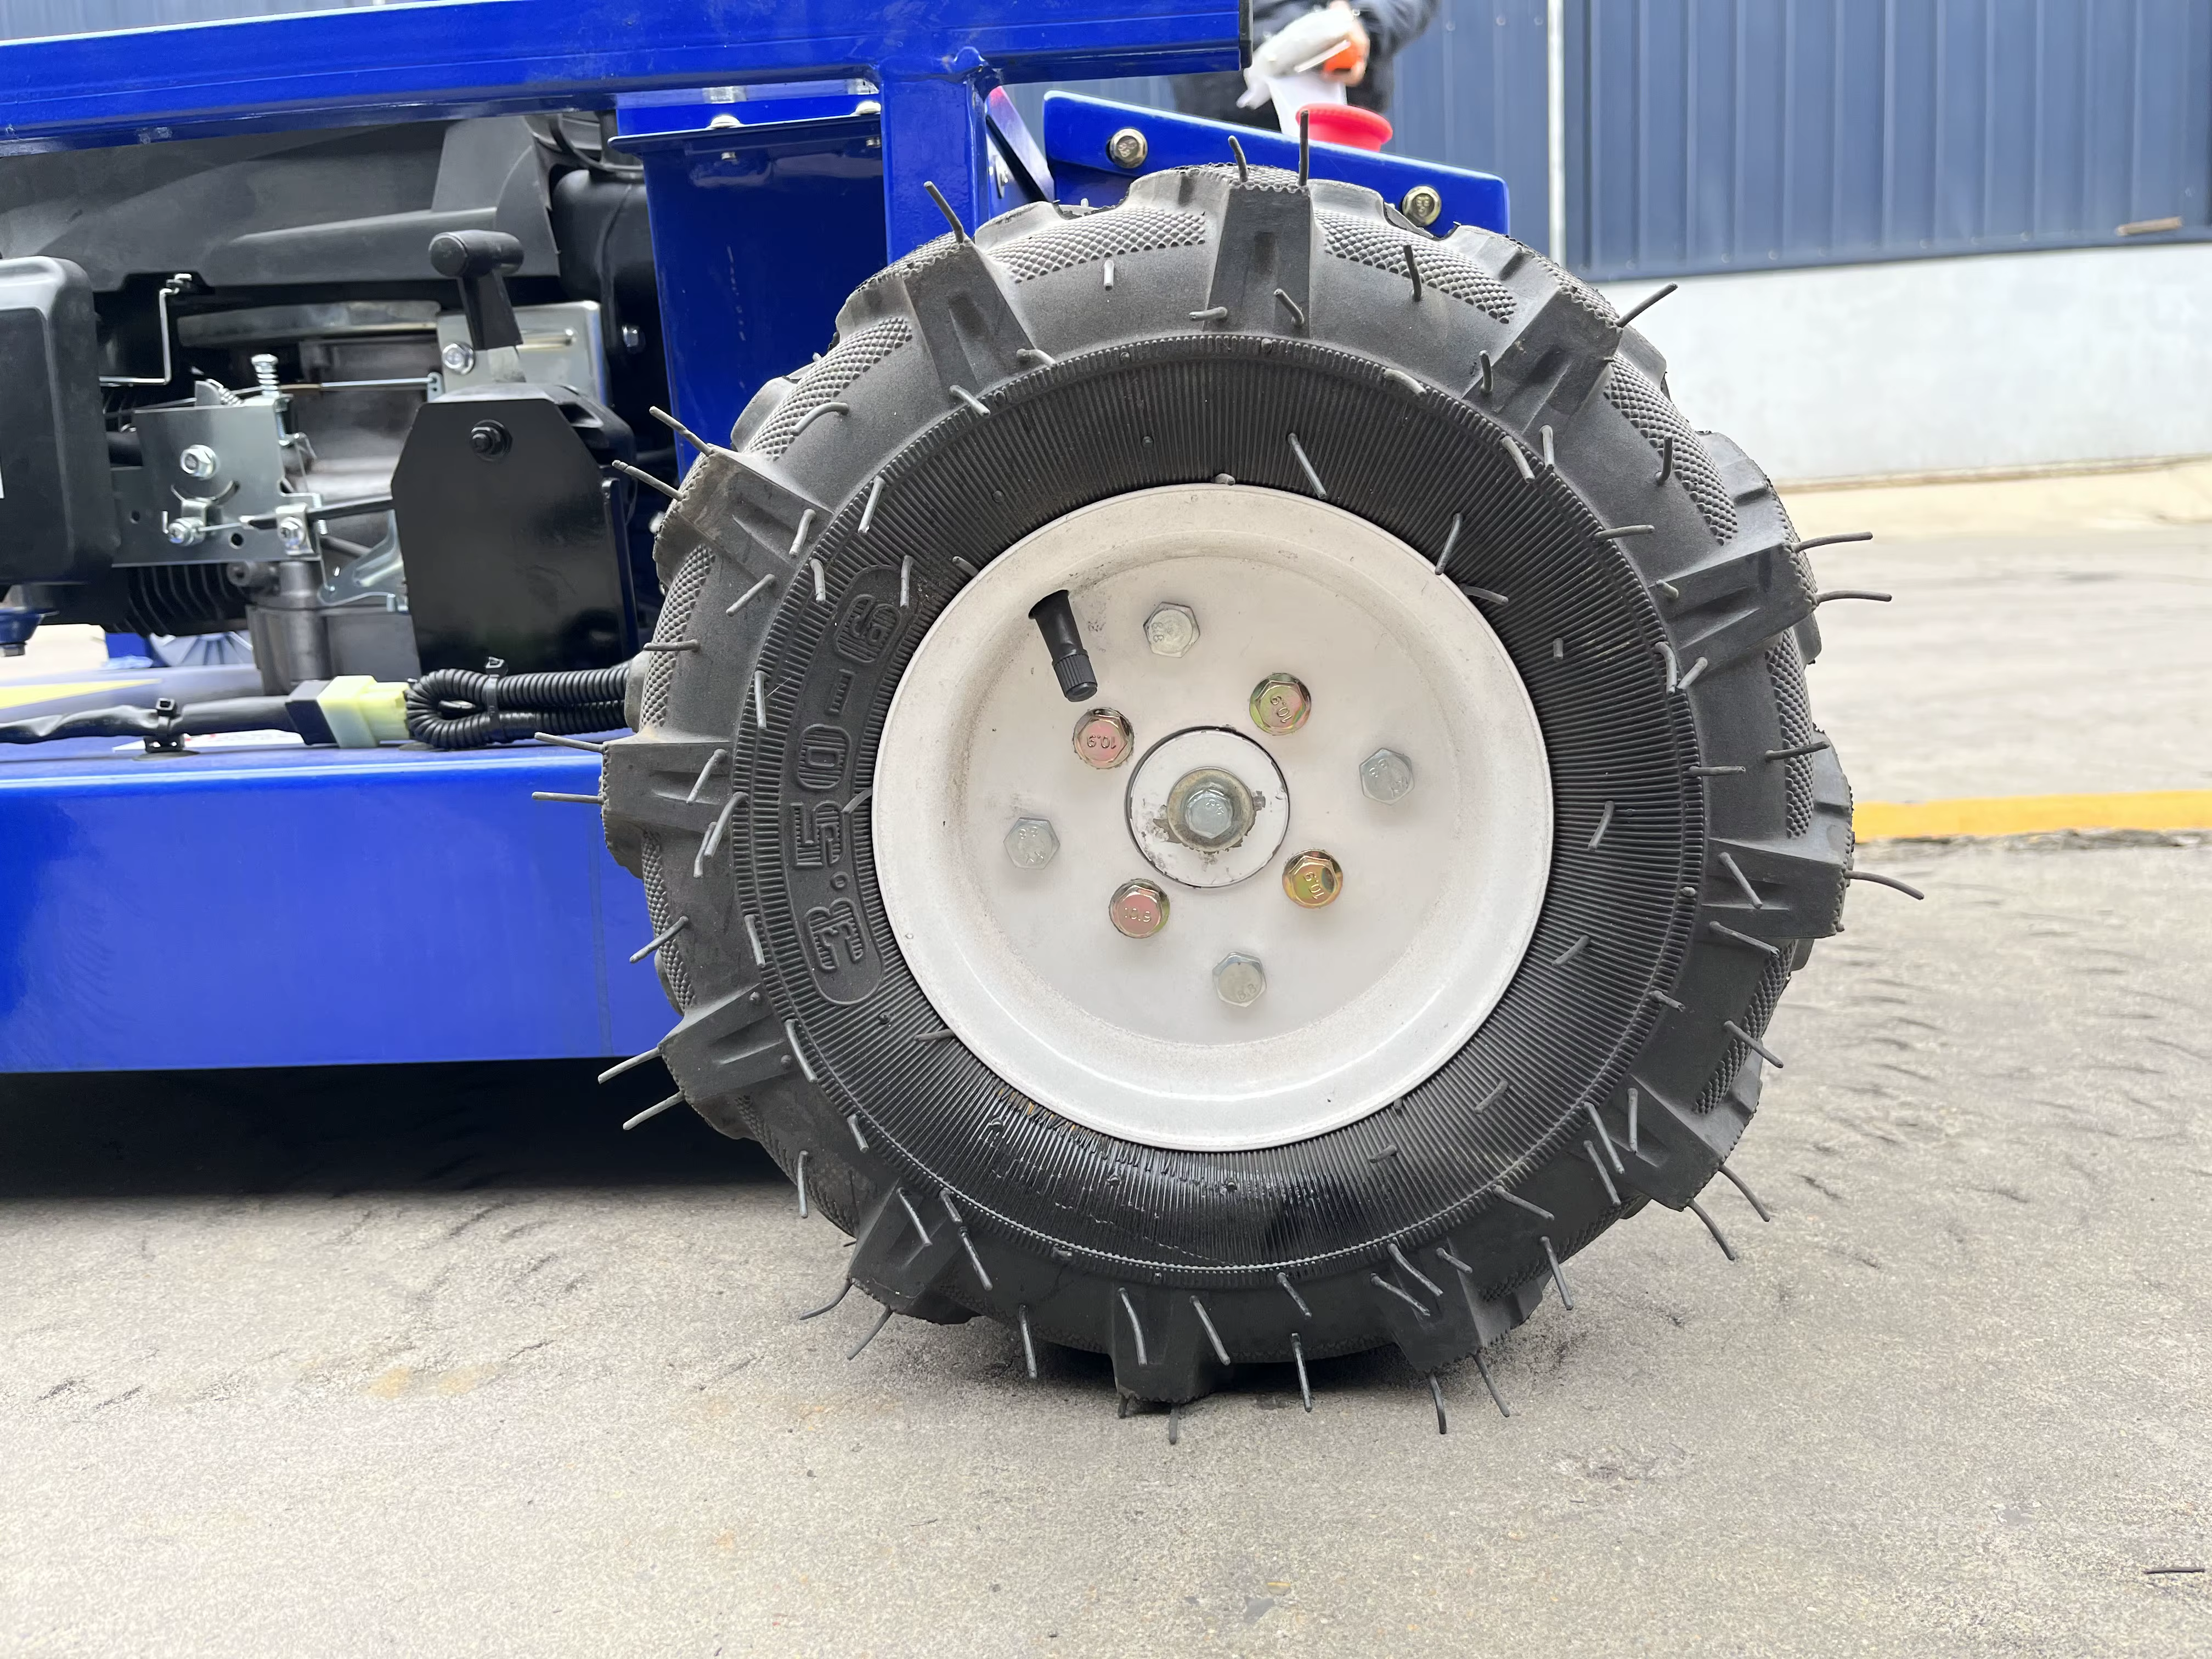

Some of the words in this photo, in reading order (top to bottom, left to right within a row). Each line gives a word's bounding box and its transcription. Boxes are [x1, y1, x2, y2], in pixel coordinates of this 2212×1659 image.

[1269, 694, 1293, 724] 10.9
[1087, 734, 1117, 749] 10.9
[791, 593, 901, 973] 3.50-6
[1303, 871, 1324, 899] 10.9
